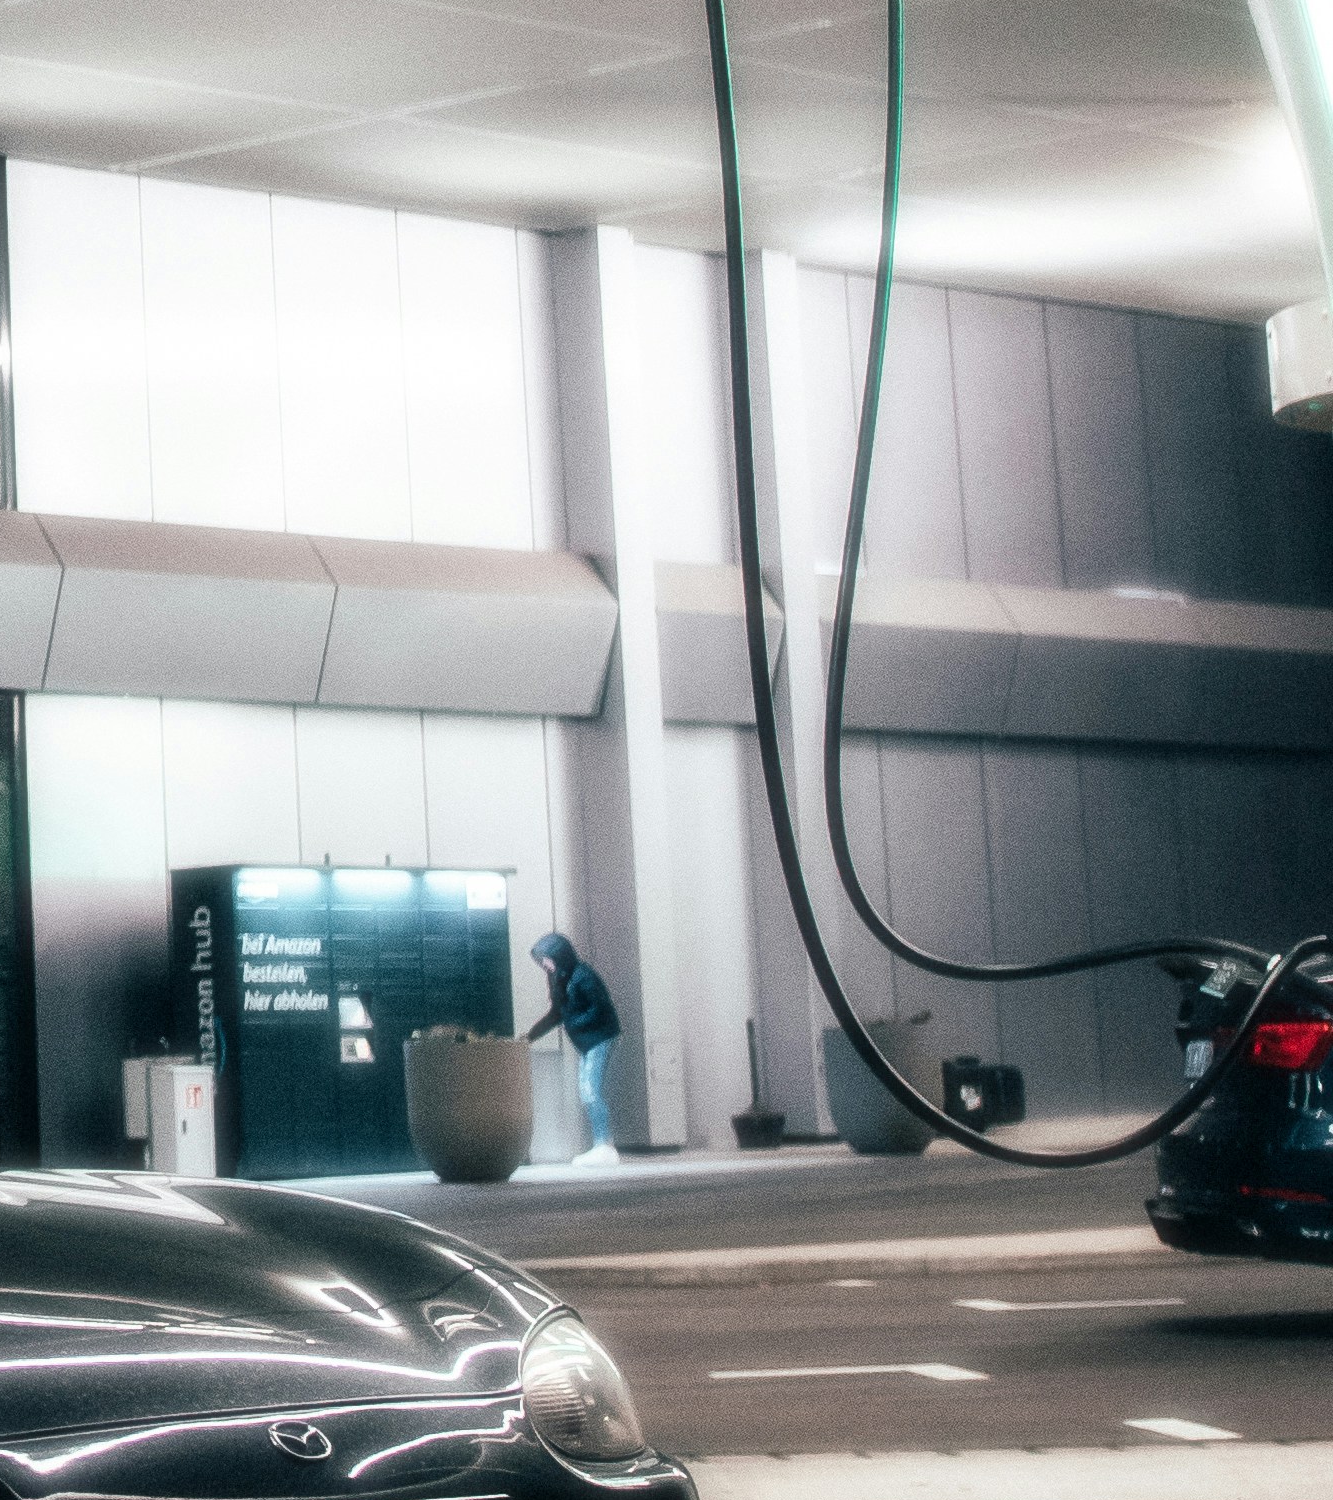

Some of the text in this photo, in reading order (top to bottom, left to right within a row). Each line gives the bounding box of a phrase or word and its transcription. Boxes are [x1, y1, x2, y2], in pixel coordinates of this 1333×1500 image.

[187, 904, 213, 972] hub
[241, 932, 322, 956] bei Amazon
[243, 988, 329, 1012] hier abholen
